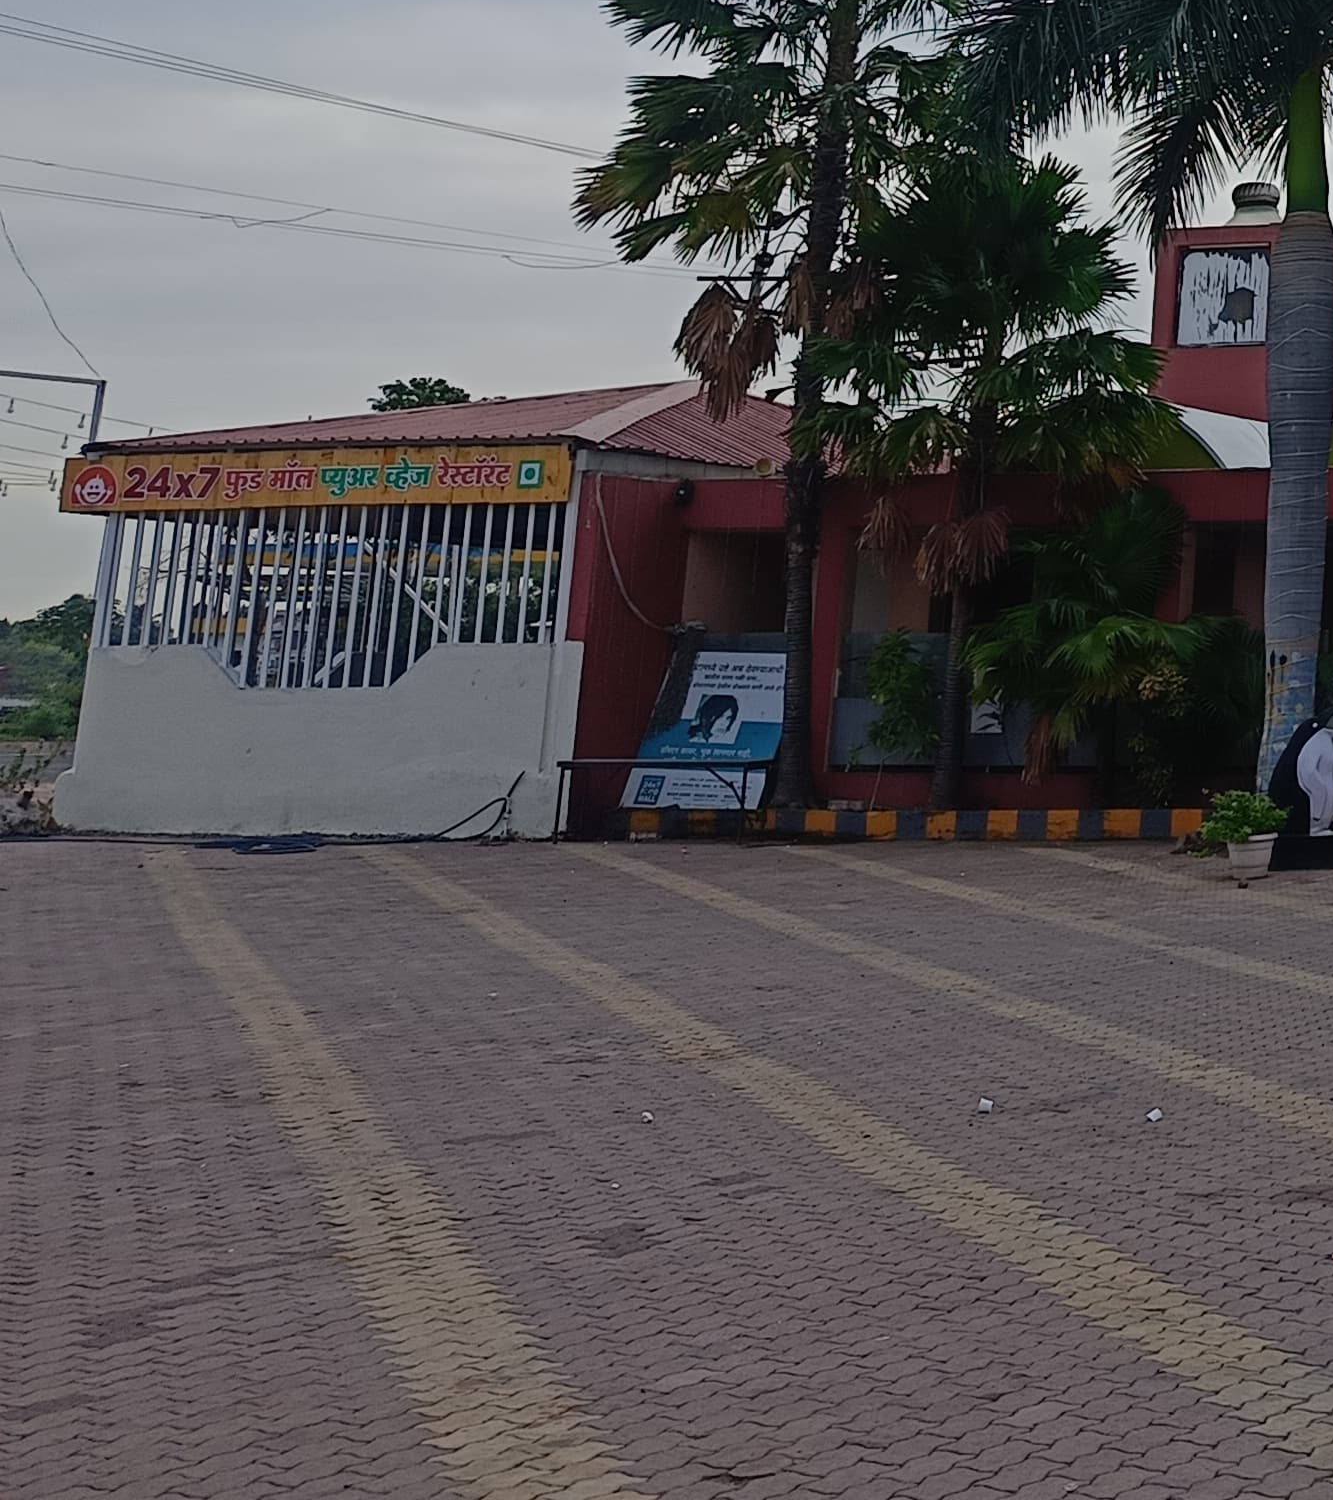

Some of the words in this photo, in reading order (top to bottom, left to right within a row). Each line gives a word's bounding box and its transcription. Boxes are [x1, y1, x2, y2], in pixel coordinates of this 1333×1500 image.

[123, 465, 222, 500] 24x7
[223, 469, 265, 500] फुड
[268, 459, 316, 492] मॉल
